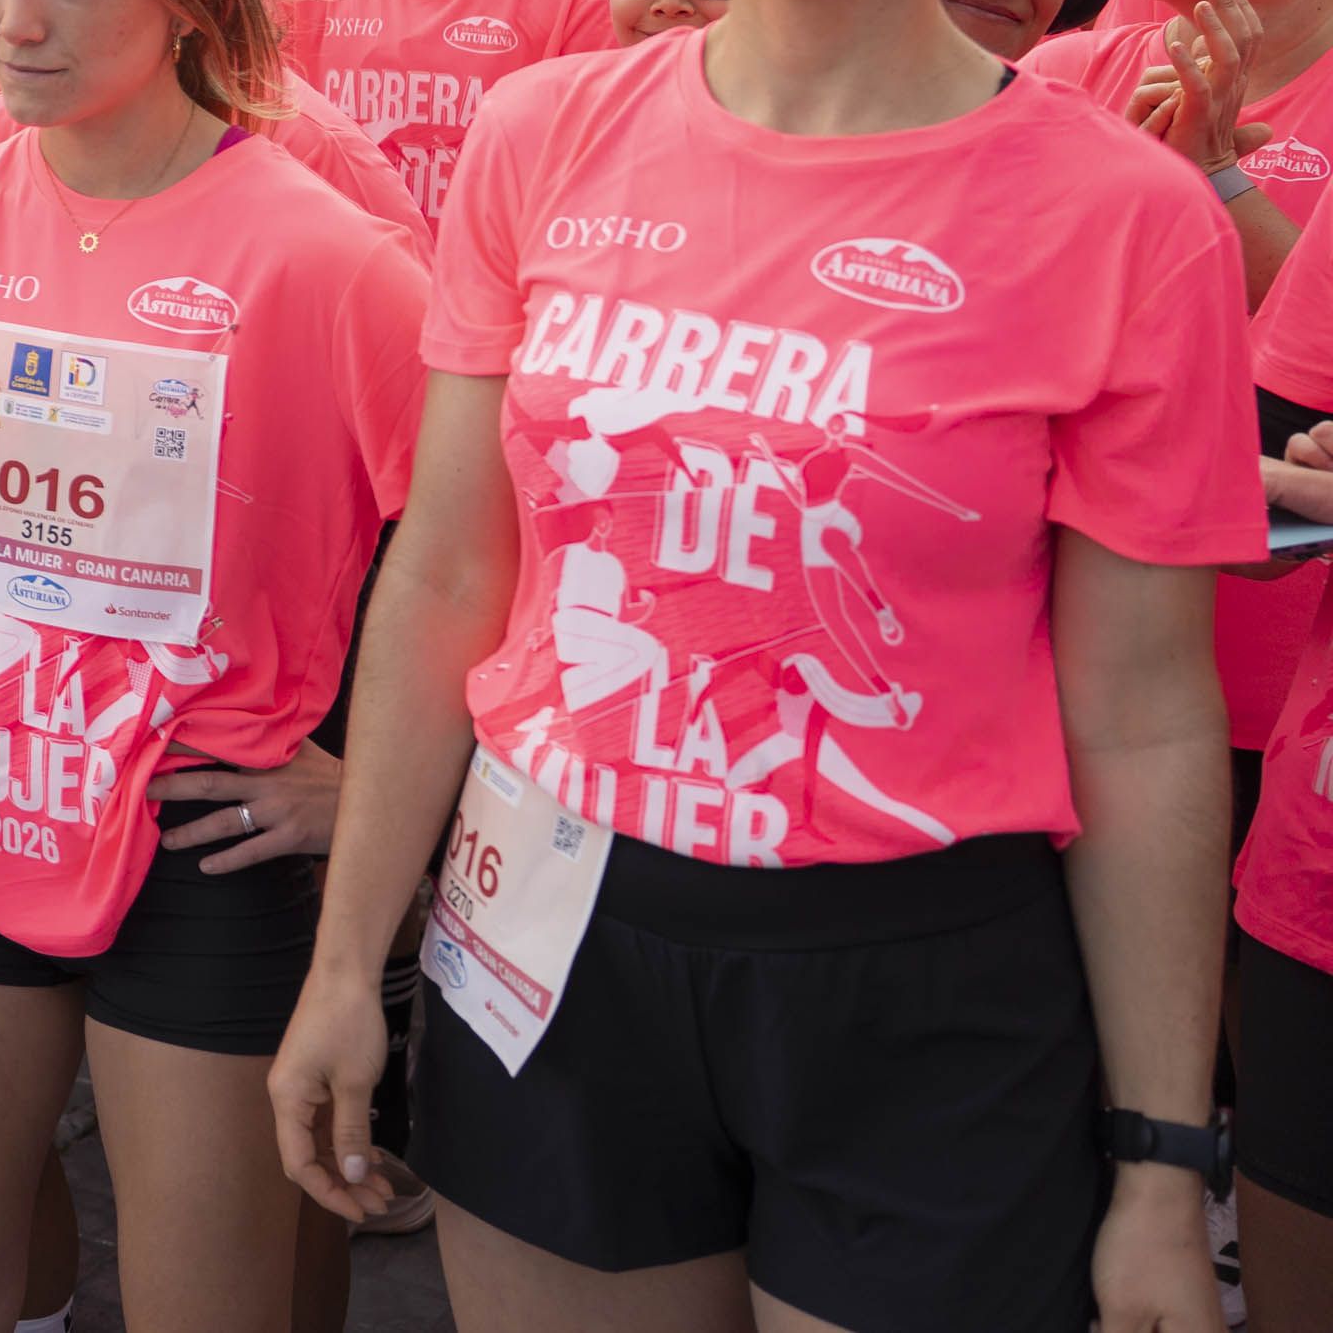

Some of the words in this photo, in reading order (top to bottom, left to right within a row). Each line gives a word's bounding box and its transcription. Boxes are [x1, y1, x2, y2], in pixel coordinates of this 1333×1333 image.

[1243, 153, 1321, 177] ASTRIANA
[546, 215, 687, 253] OYSHO
[823, 252, 952, 307] ASTURIANA
[133, 292, 231, 325] ASTURIANA
[520, 291, 873, 437] CARRERA
[21, 519, 73, 547] 3155
[651, 437, 801, 592] DE
[15, 549, 63, 570] MUJER
[75, 558, 116, 580] GRAN
[120, 566, 190, 588] CANARIA
[10, 583, 67, 608] ASTURIANA
[118, 606, 172, 621] Santander
[20, 634, 86, 737] LA
[631, 654, 728, 780] LA
[447, 809, 503, 898] 016
